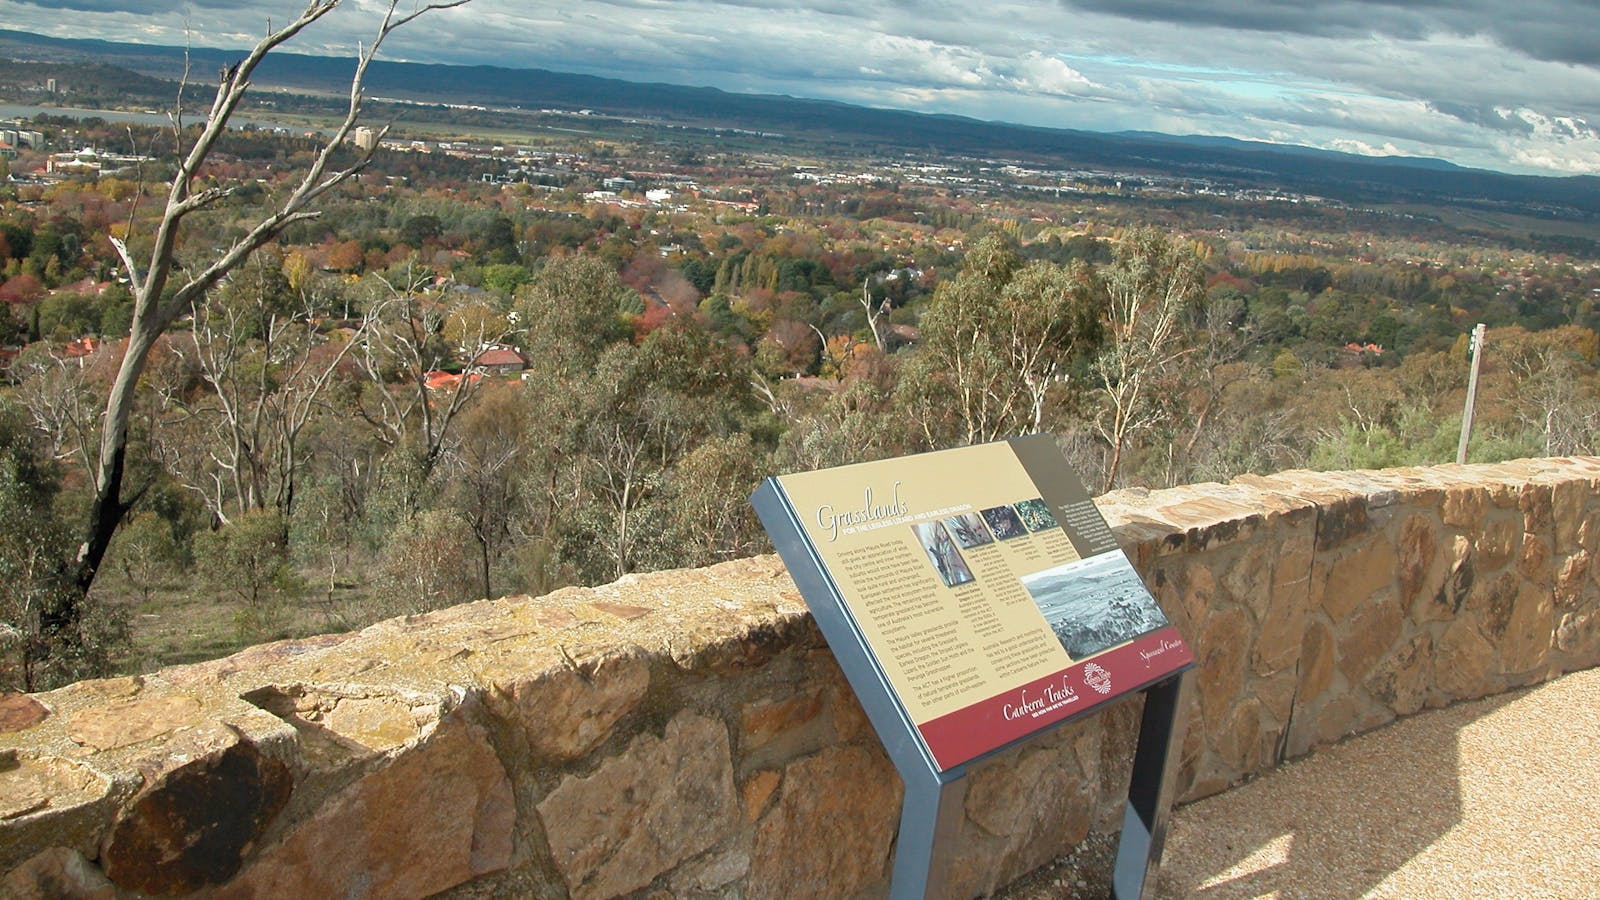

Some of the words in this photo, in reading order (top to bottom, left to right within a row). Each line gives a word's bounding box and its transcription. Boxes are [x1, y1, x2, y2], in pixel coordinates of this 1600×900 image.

[818, 481, 908, 542] Grasslands
[1004, 690, 1034, 720] Canberra
[1044, 675, 1074, 702] Tracks
